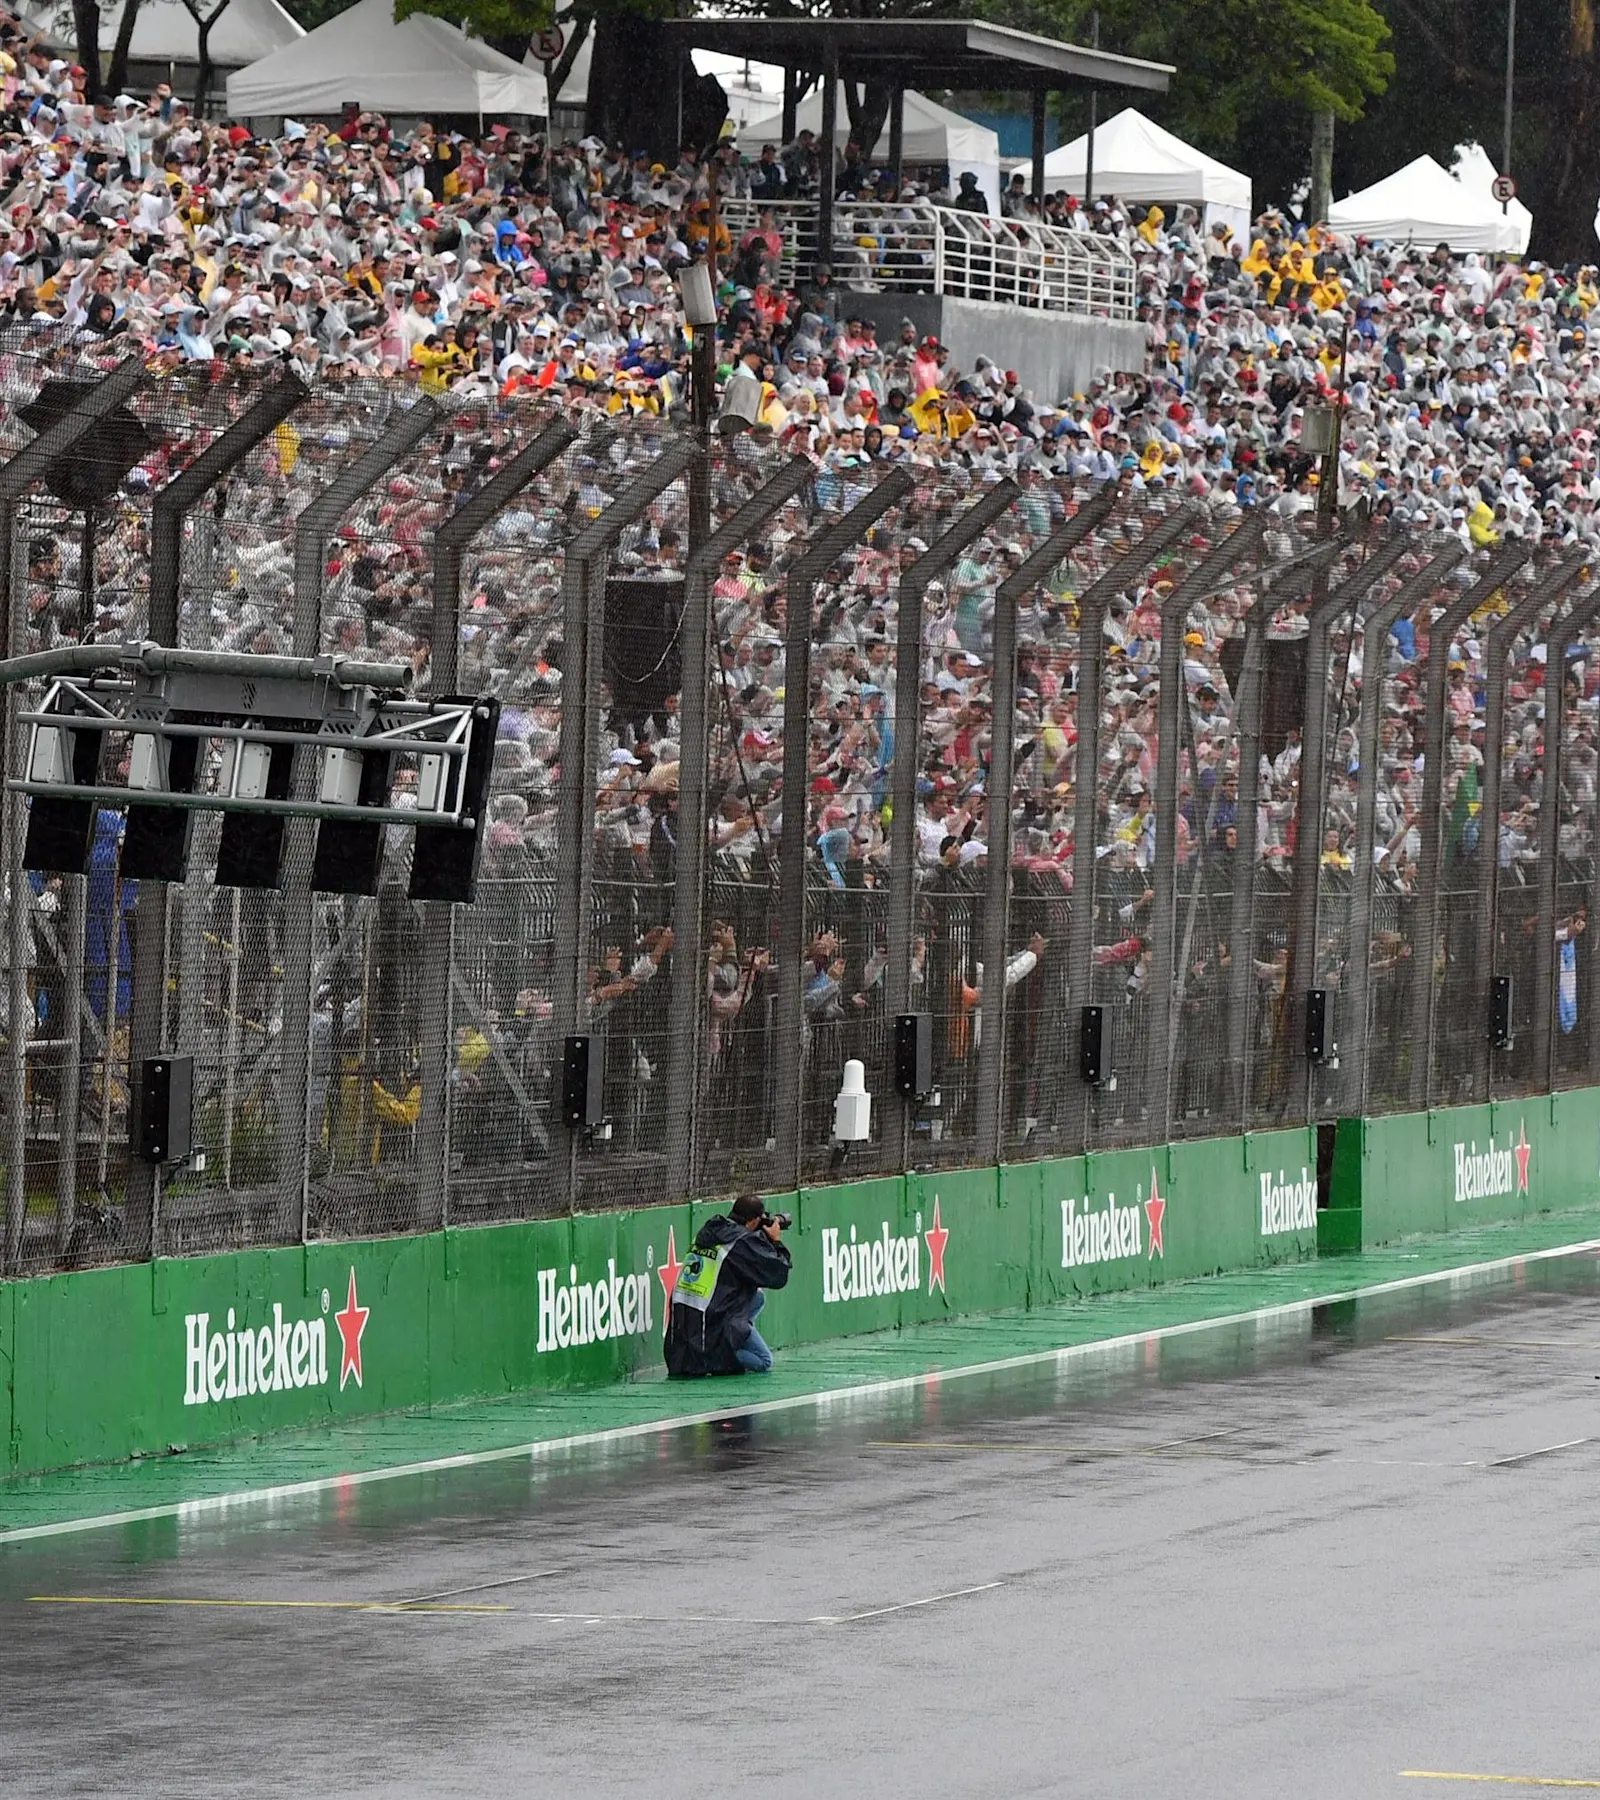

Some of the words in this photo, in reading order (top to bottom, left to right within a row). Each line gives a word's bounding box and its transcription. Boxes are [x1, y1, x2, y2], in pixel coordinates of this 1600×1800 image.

[1454, 1138, 1513, 1201] Heineken
[821, 1221, 921, 1303] Heineken
[1061, 1192, 1142, 1268] Heineken
[537, 1258, 653, 1352] Heineken
[184, 1303, 328, 1405] Heineken
